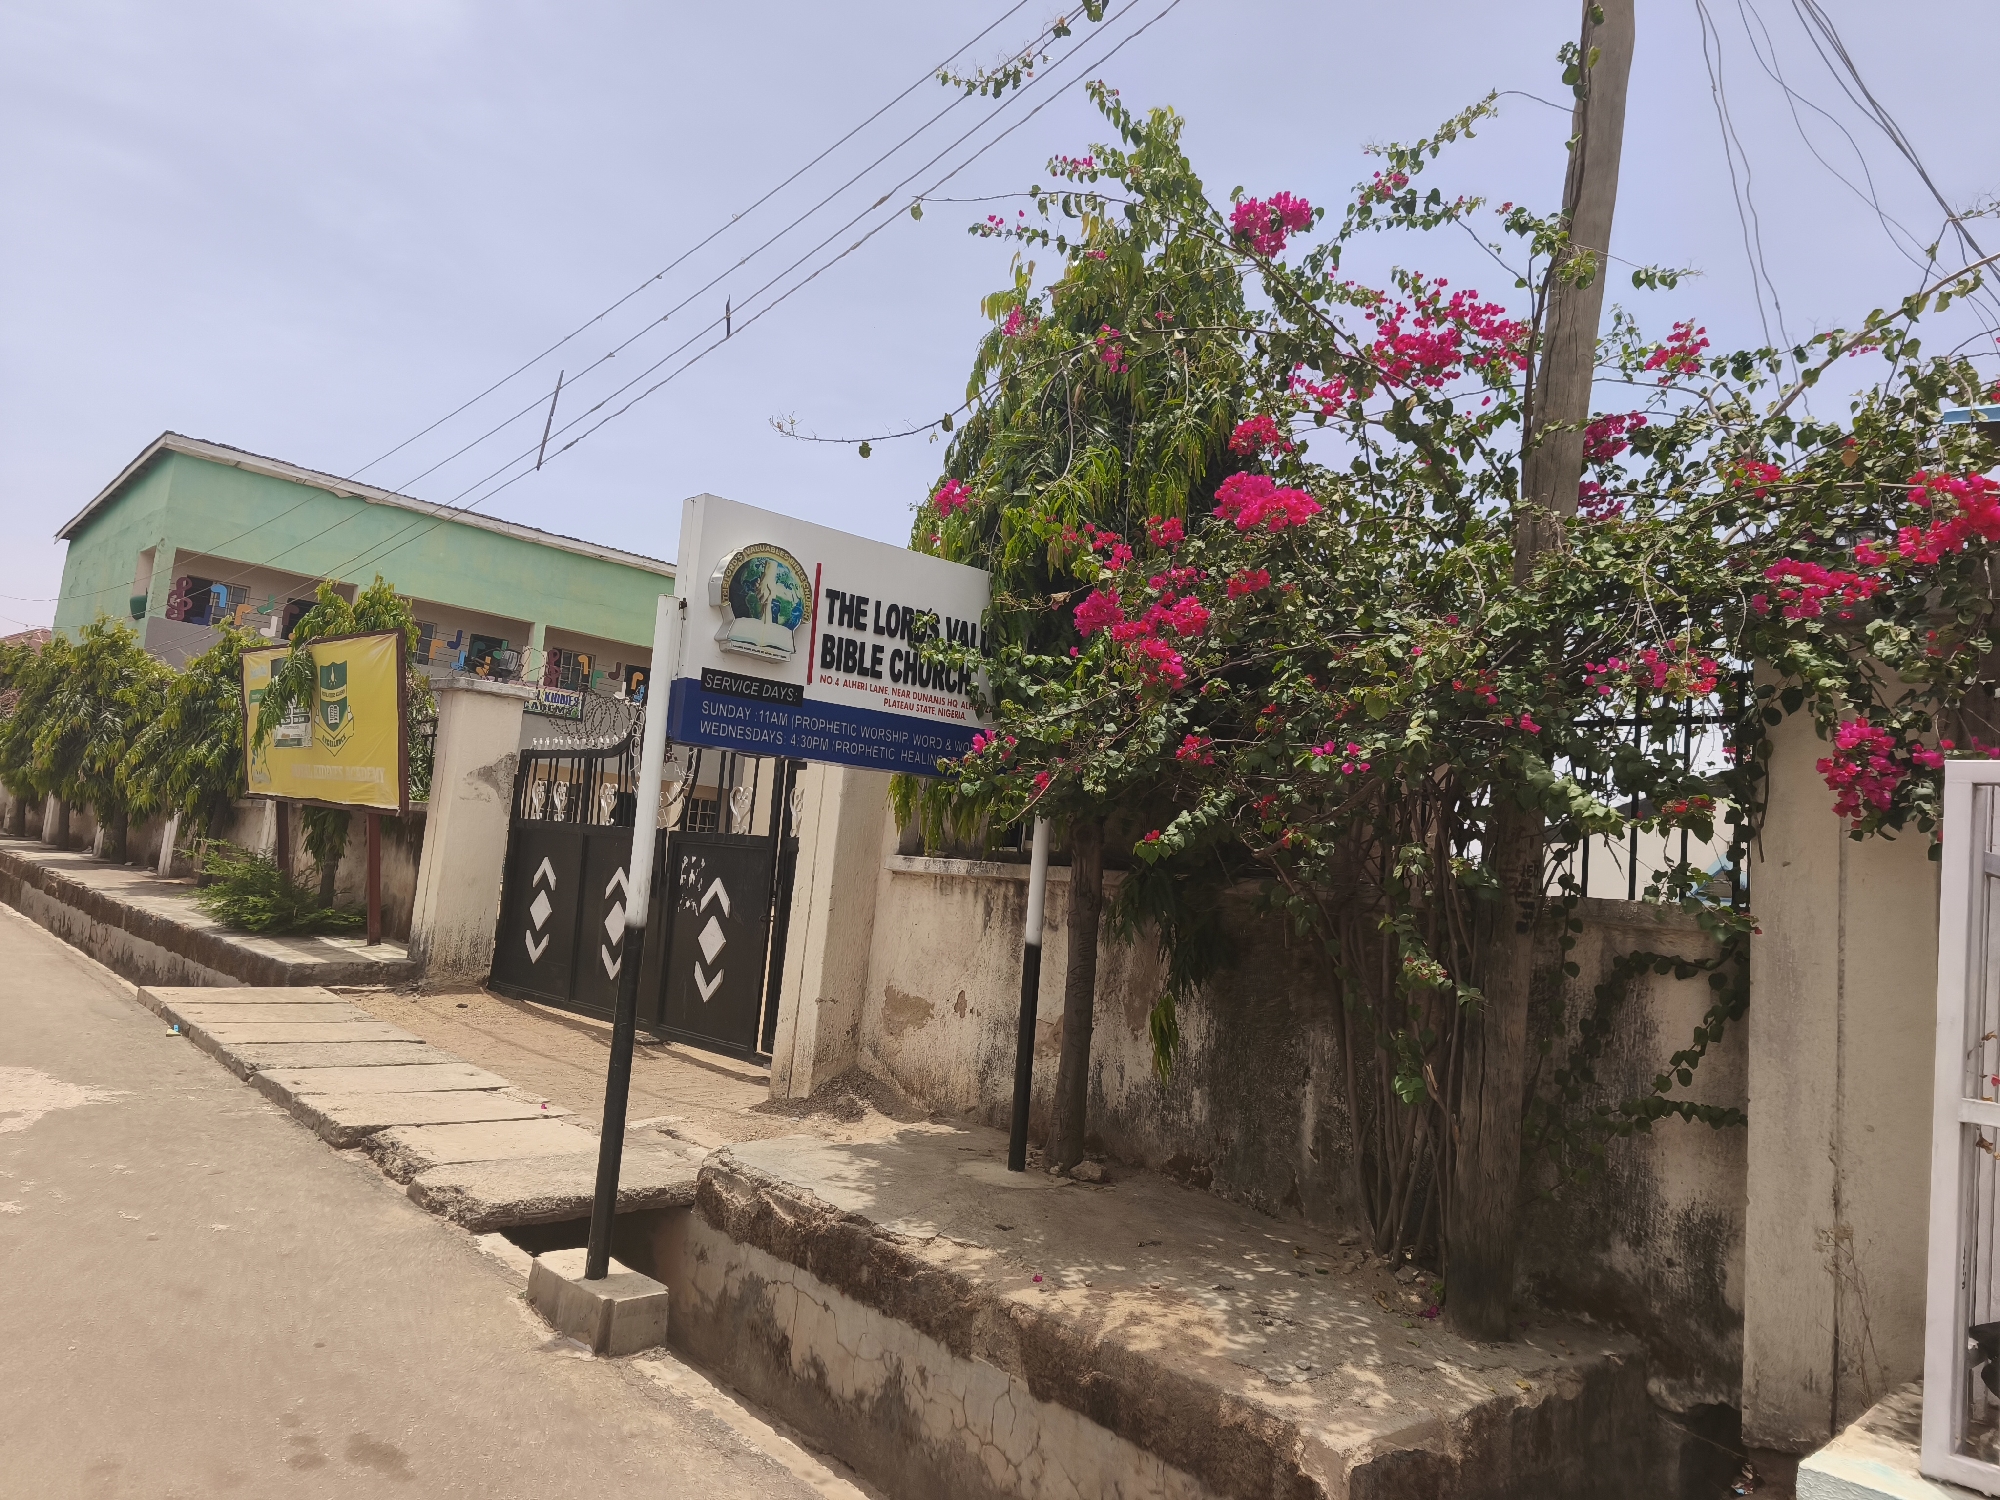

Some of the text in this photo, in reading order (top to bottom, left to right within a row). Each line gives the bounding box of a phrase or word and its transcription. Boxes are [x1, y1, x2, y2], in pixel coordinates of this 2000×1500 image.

[721, 580, 730, 602] THE
[744, 544, 791, 560] VALUABLES
[826, 588, 869, 631] THE
[820, 633, 973, 696] BIBLE CHURCH
[544, 691, 580, 707] KIDDIES
[704, 674, 798, 702] SERVICE DAYS:
[820, 674, 840, 687] NO.4
[843, 679, 868, 691] ALHERI
[892, 687, 911, 699] NEAR
[883, 698, 914, 711] PLATEAU
[701, 701, 752, 721] SUNDAY
[913, 733, 943, 750] WORD
[945, 738, 952, 751] &
[790, 733, 829, 751] 4:30PM
